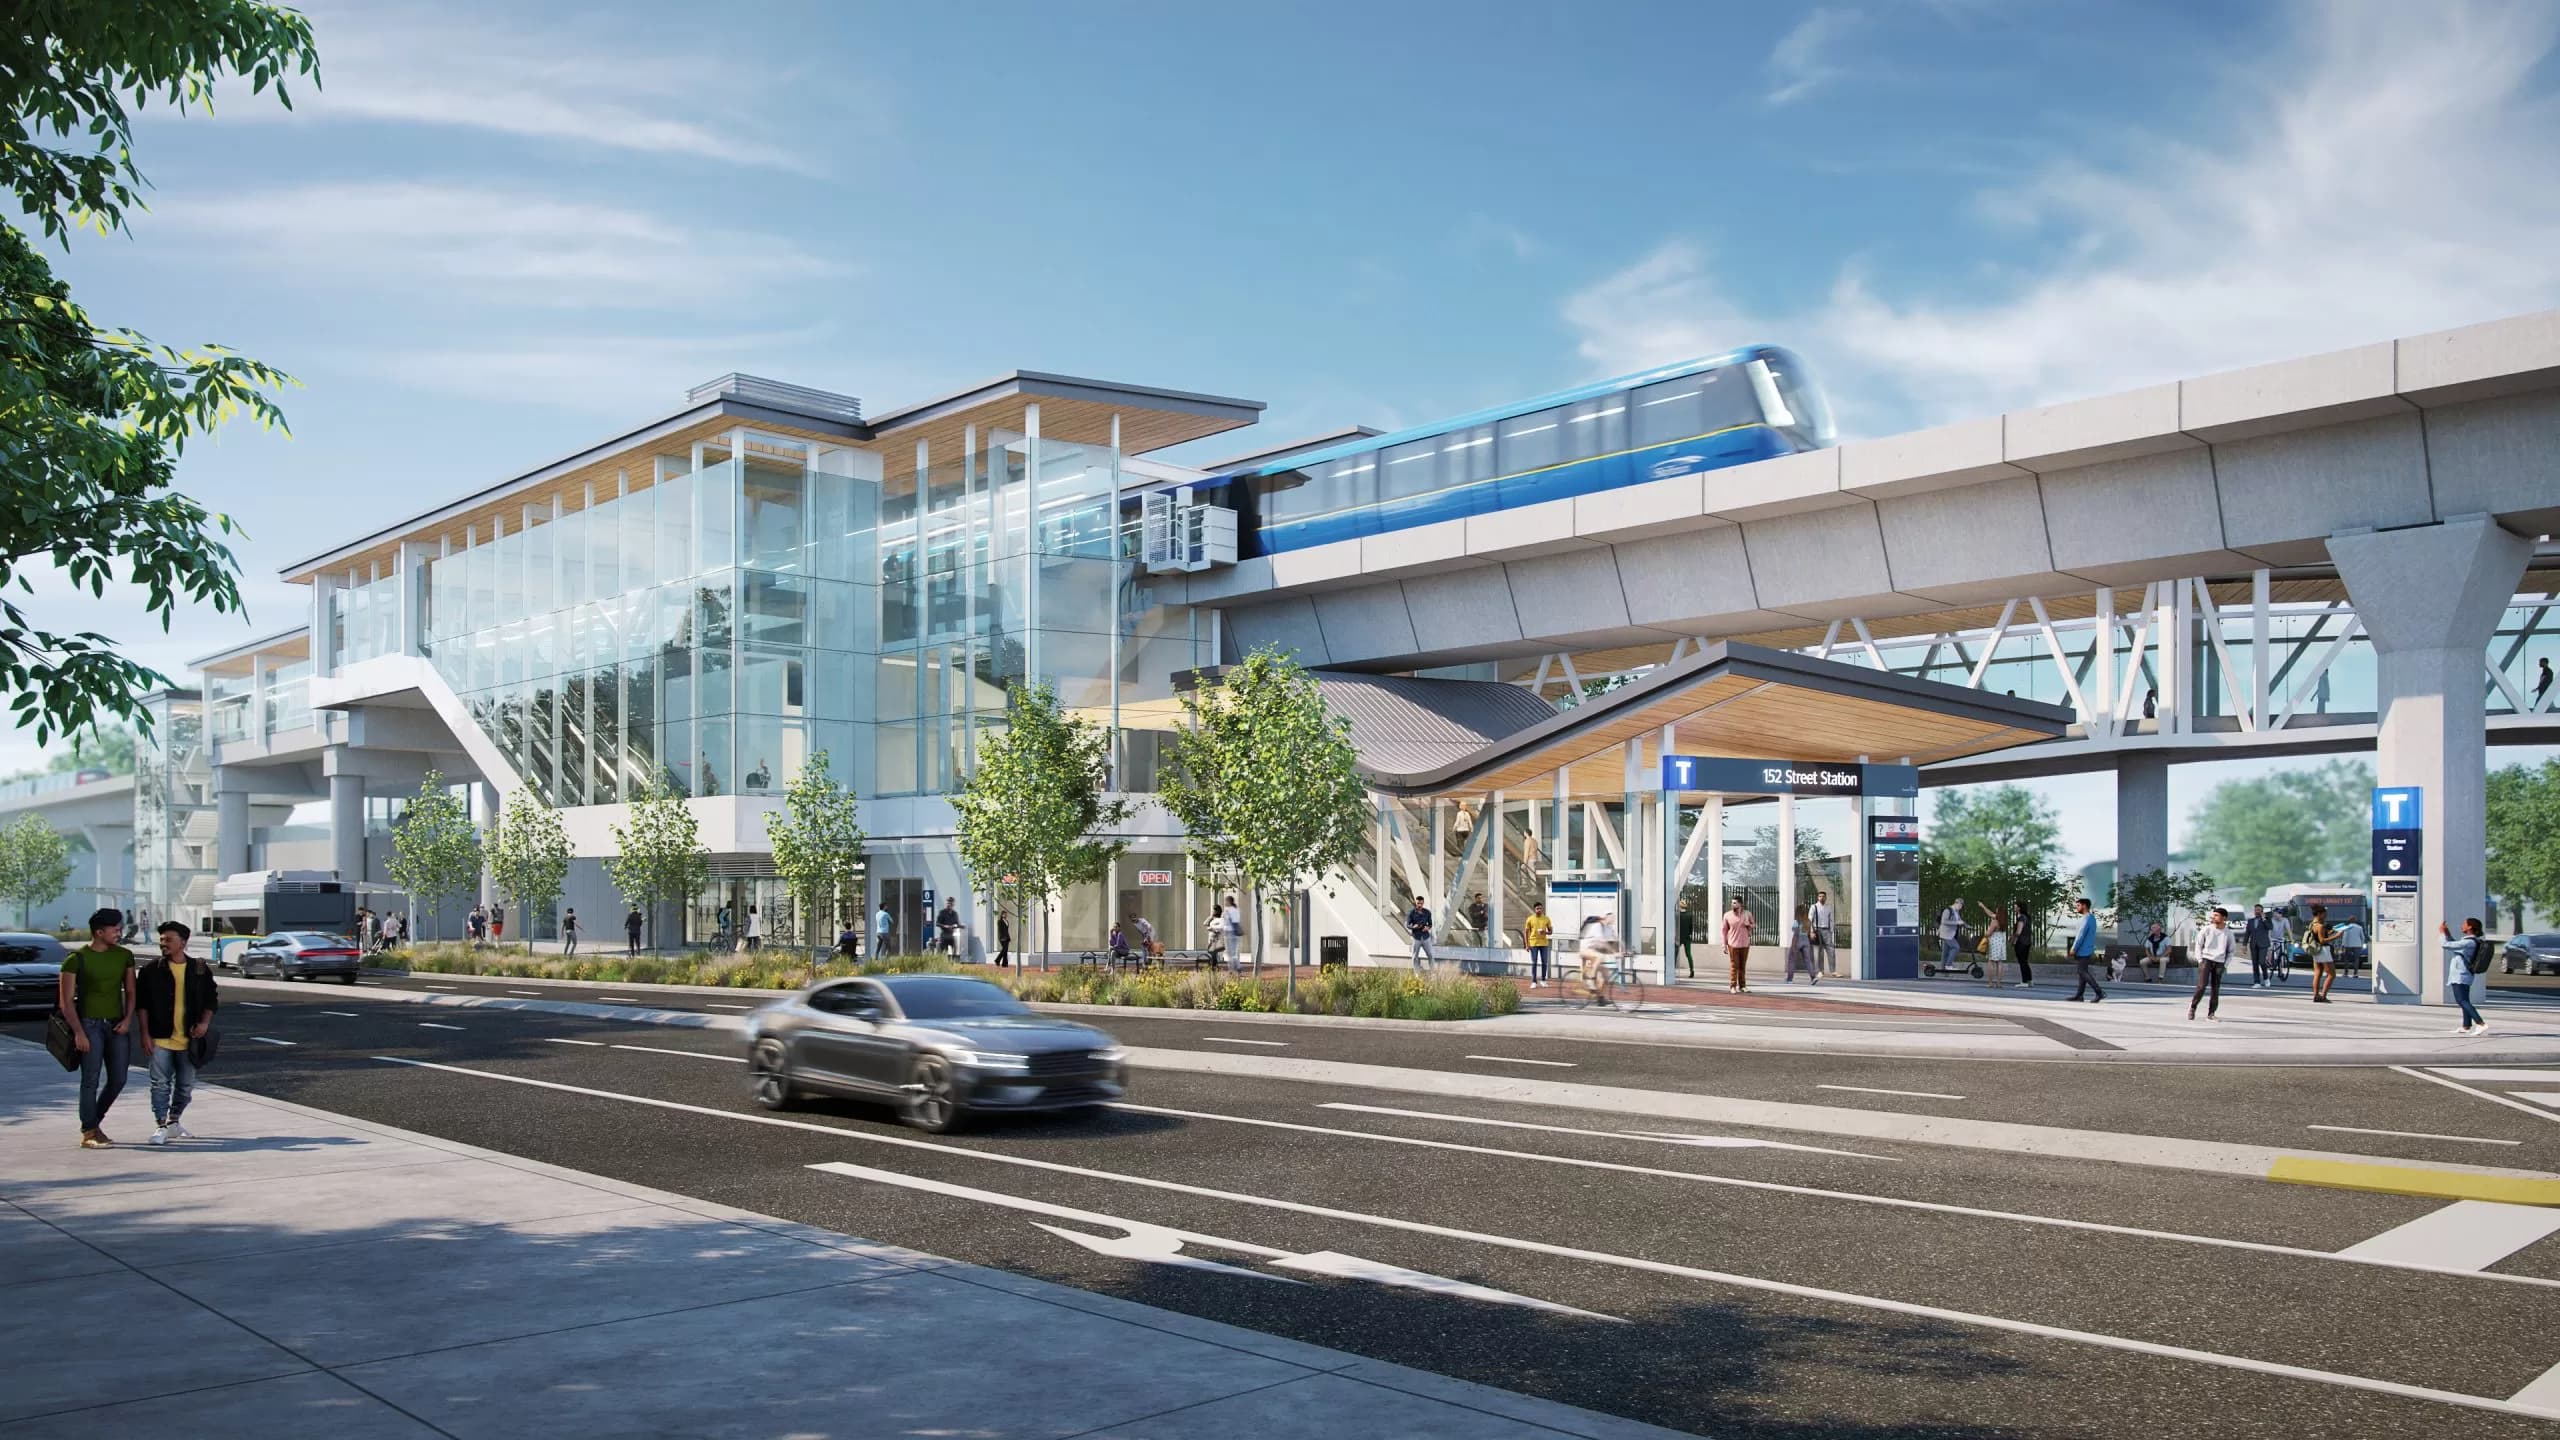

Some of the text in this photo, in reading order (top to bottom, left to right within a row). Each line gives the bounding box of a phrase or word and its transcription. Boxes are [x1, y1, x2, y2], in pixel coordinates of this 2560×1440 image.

[1675, 760, 1692, 784] T
[1763, 768, 1857, 786] 152 Street Station
[2382, 794, 2408, 822] T
[1142, 873, 1169, 883] OPEN
